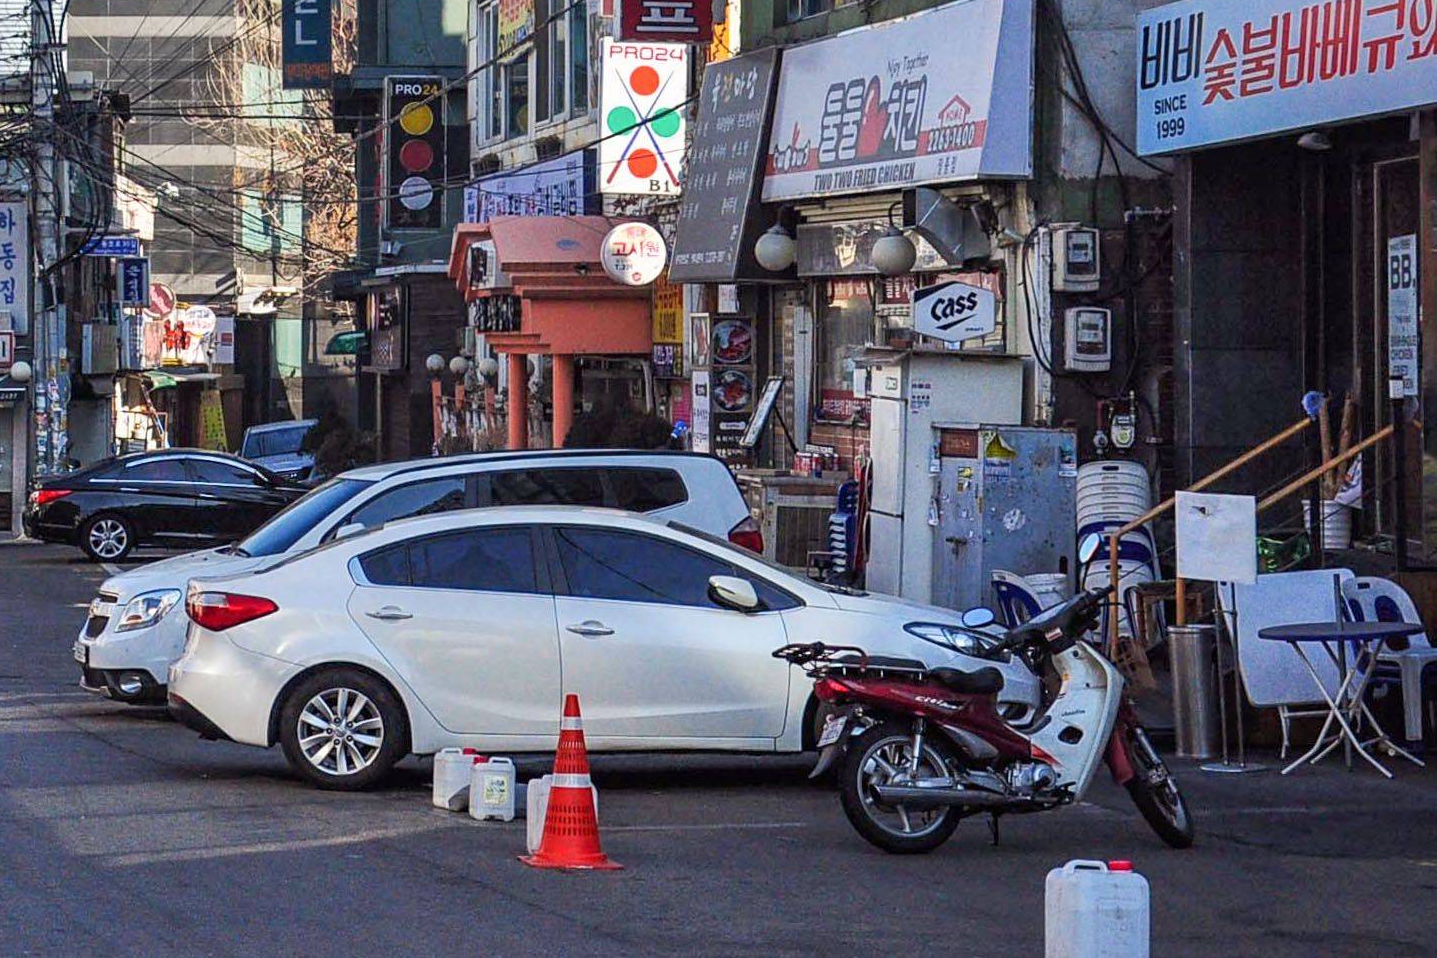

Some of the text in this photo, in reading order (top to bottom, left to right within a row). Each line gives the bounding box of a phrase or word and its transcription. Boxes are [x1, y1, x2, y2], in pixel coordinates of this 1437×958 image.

[609, 45, 684, 62] PRO24
[1140, 12, 1203, 90] 비비
[395, 84, 439, 96] PRO24
[1154, 94, 1187, 115] SINCE
[926, 122, 976, 153] 2263-1400
[1156, 117, 1185, 139] 1999
[648, 179, 672, 193] B1
[814, 162, 916, 190] TWO TWO FRIED CHICKEN
[930, 291, 978, 323] Cass
